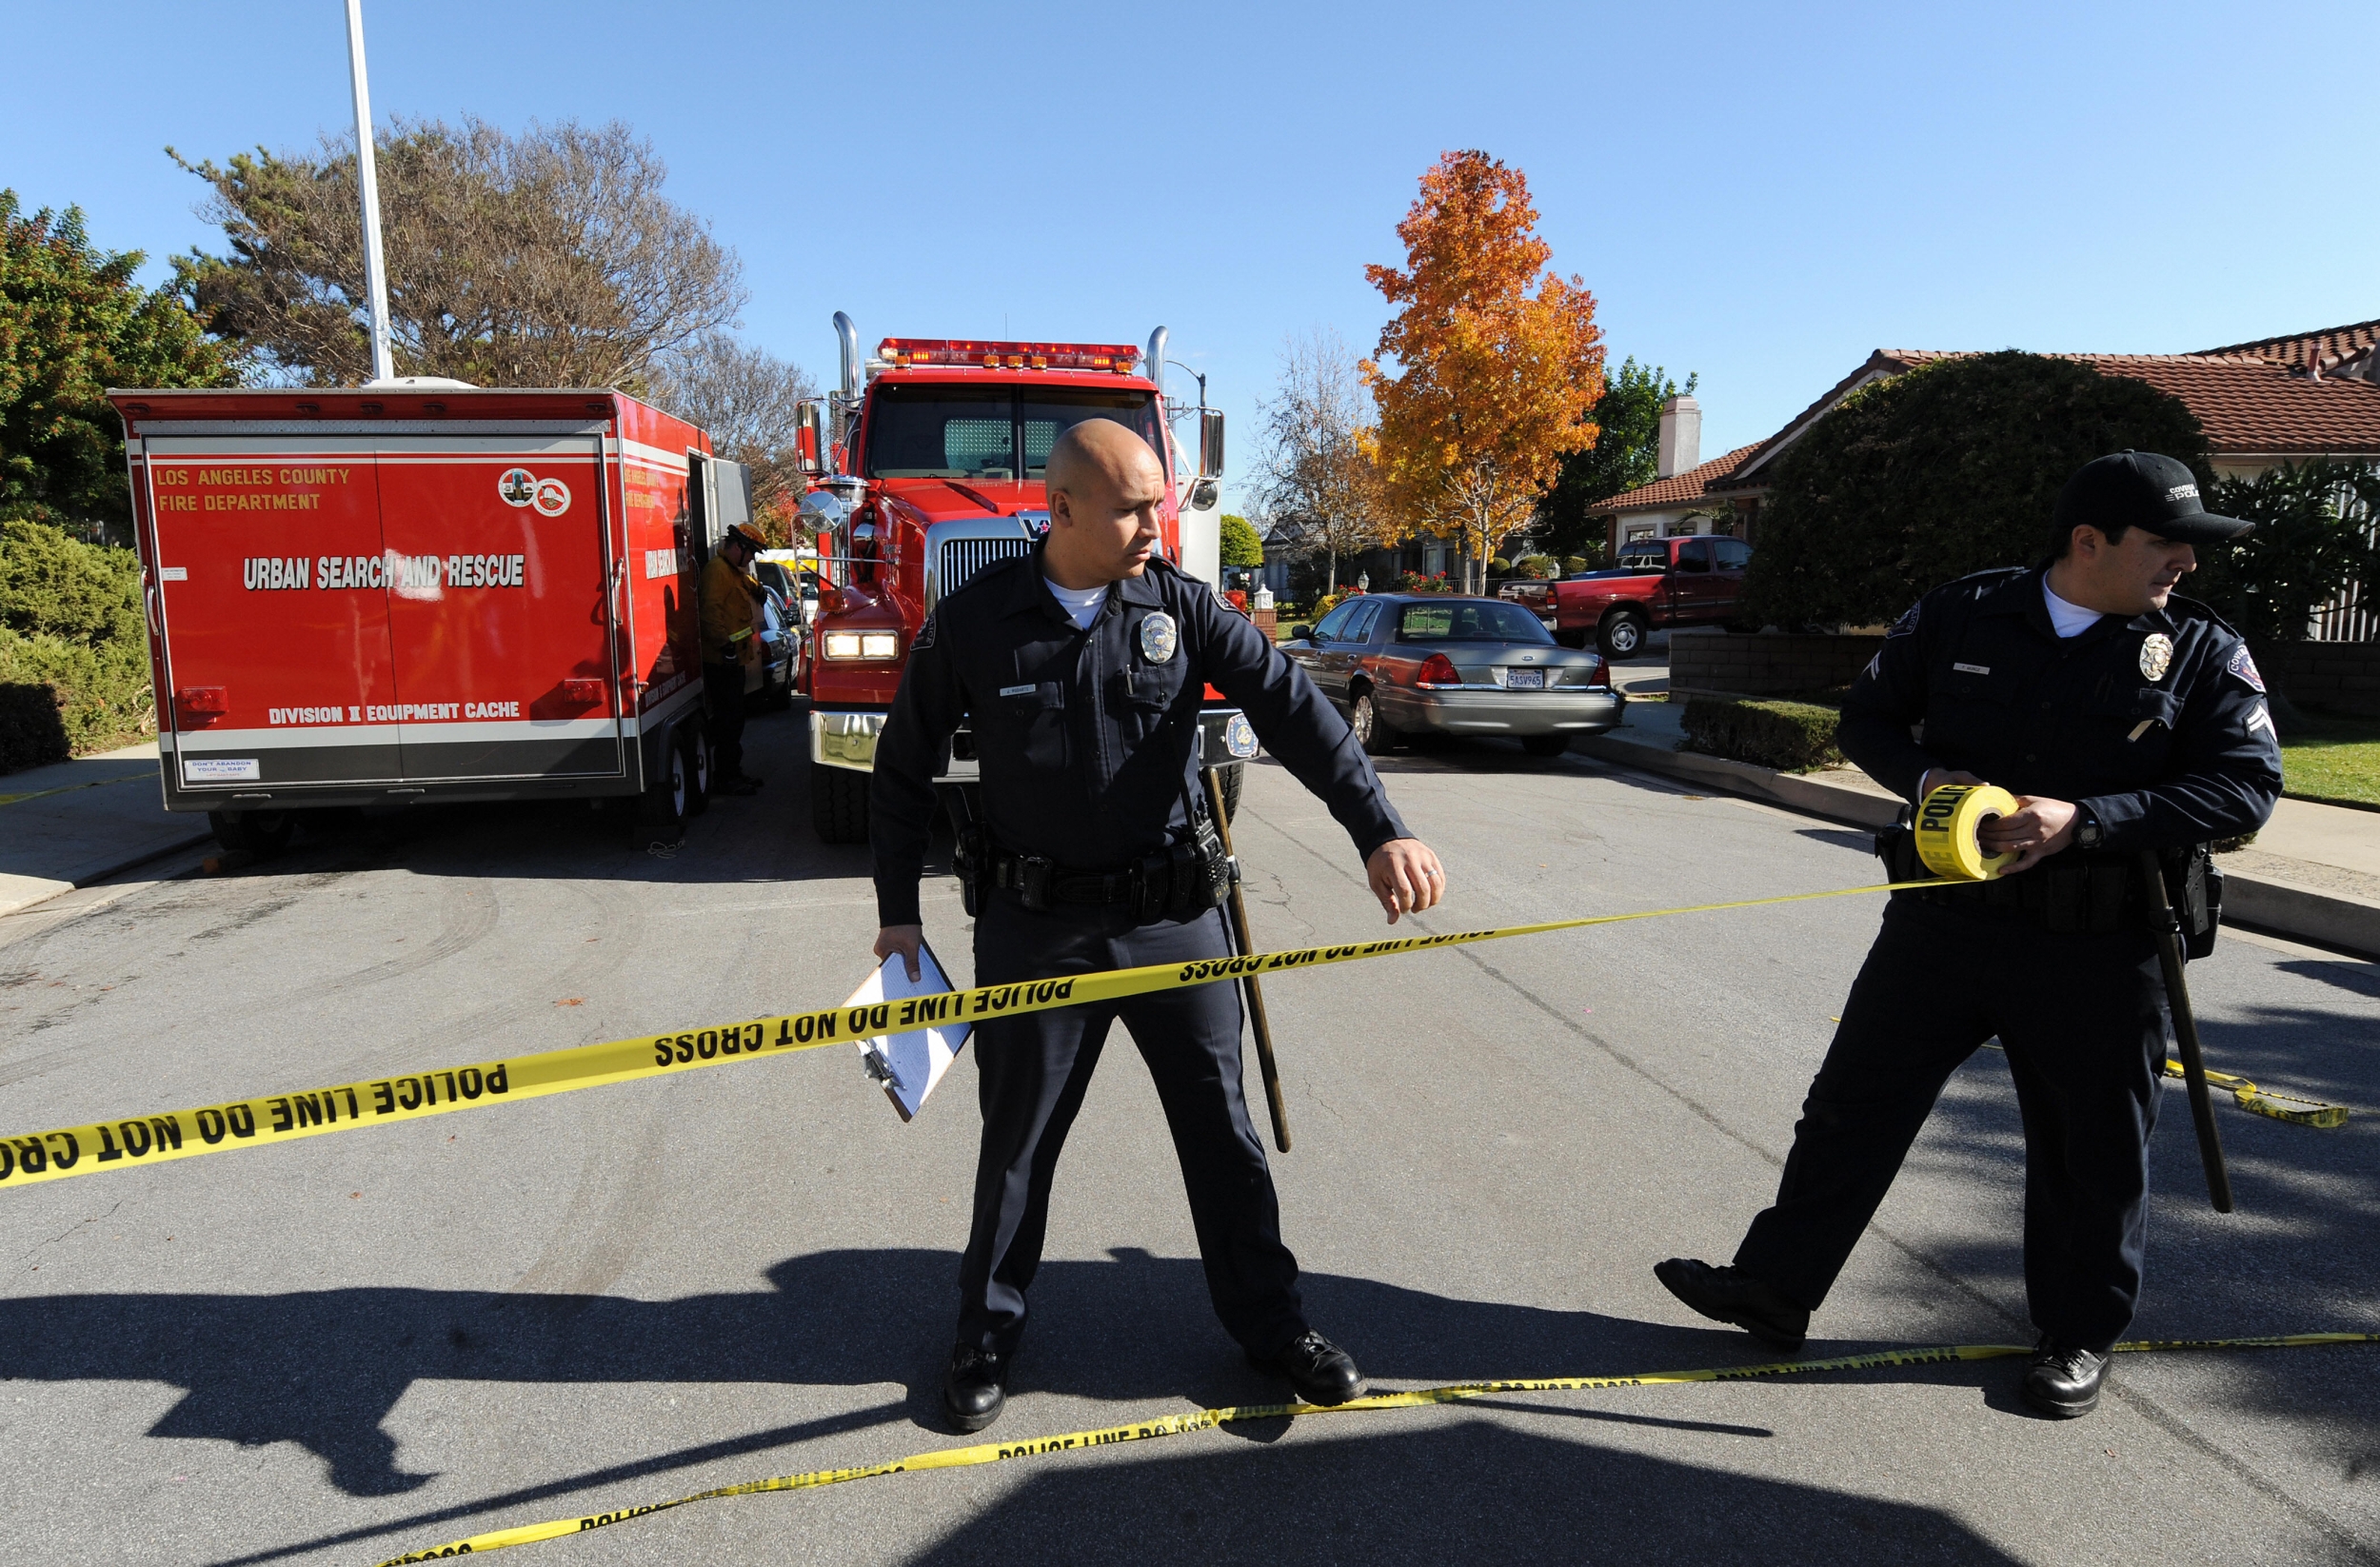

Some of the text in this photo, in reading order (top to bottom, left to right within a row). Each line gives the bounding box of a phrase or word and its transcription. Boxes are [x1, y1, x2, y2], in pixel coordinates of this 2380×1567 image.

[156, 468, 350, 486] LOS ANGELES COUNTY
[159, 493, 320, 511] FIRE DEPARTMENT
[243, 554, 525, 589] URBAN SEARCH AND RESCUE
[1510, 676, 1541, 685] 5ASV965
[268, 701, 520, 724] DIVISION II EQUIPMENT CACHE
[1180, 954, 1269, 982] CROSS
[1268, 948, 1318, 968] NOT
[654, 978, 1077, 1067] POLICE LINE DO NOT CROSS
[369, 1063, 508, 1115] POLICE
[194, 1102, 255, 1144] DO
[267, 1086, 359, 1133] LINE
[95, 1115, 183, 1162] NOT
